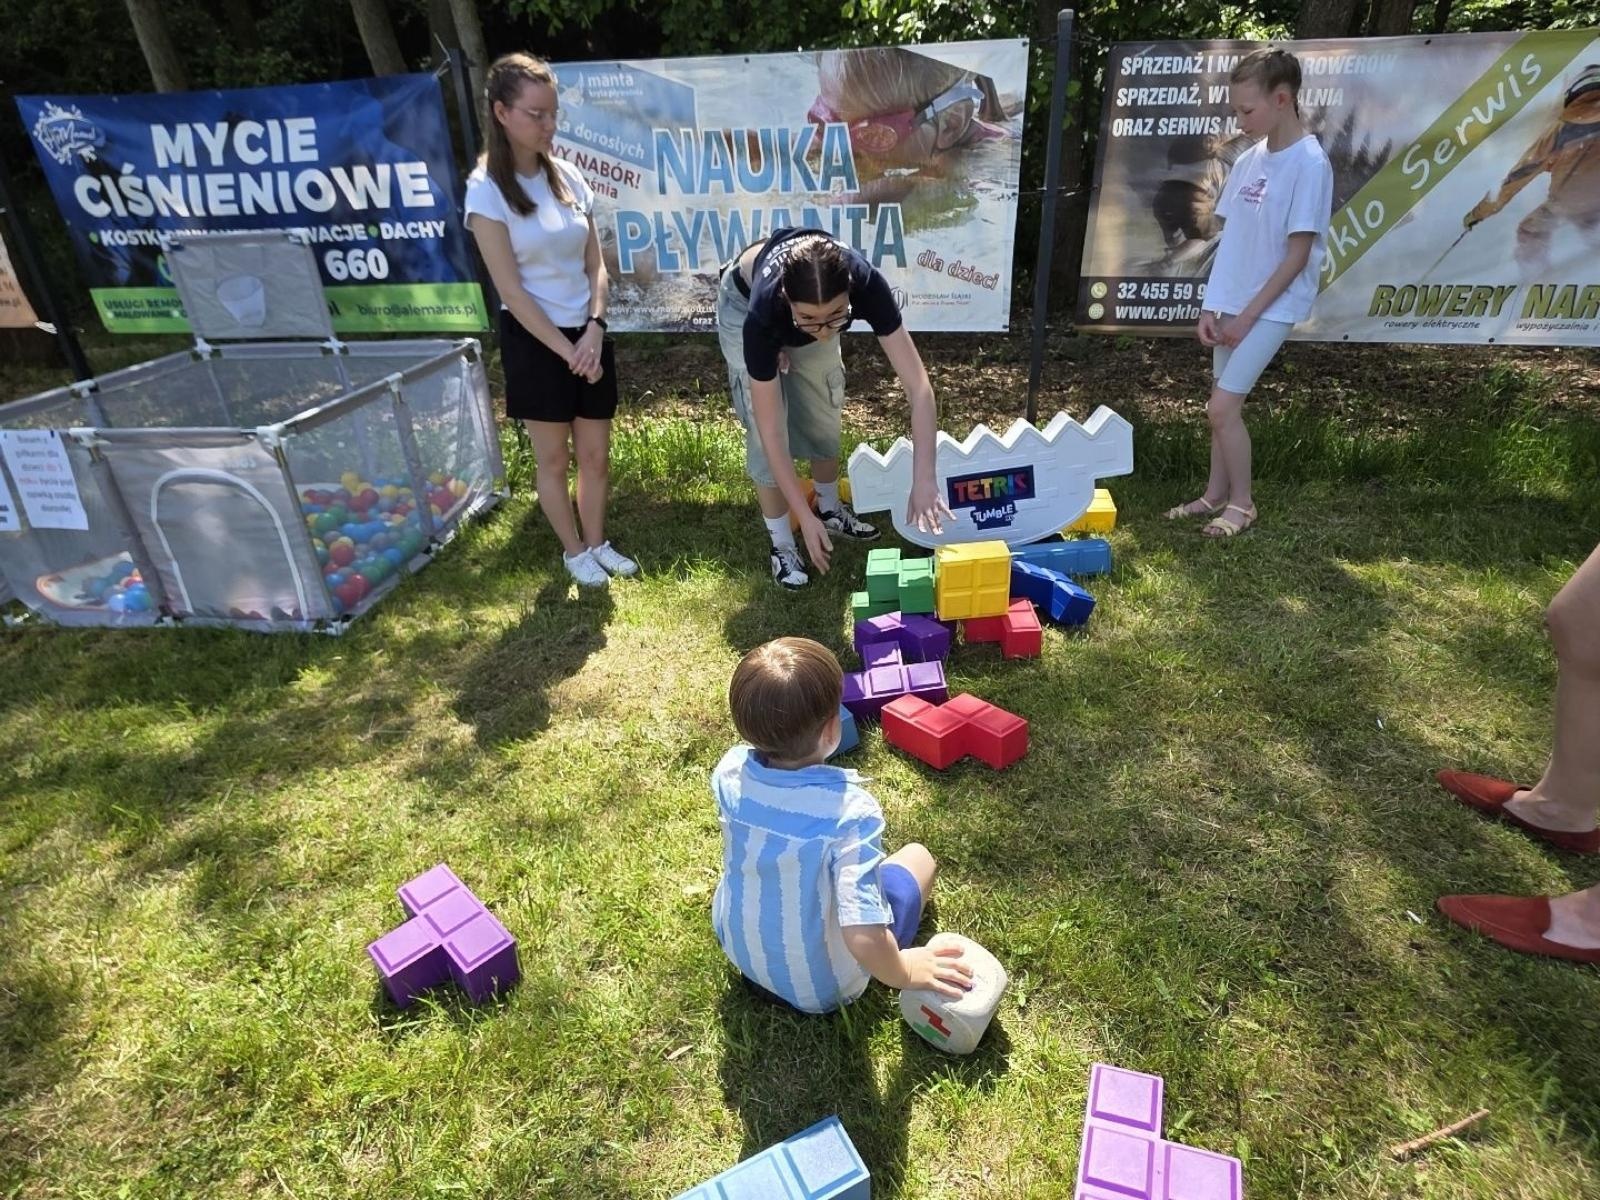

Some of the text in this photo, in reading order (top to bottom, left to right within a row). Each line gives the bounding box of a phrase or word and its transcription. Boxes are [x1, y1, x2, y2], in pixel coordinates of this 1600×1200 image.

[1120, 52, 1204, 76] SPRZEDAŻ
[1207, 55, 1214, 73] I
[587, 73, 634, 88] manta
[1117, 82, 1202, 107] SPRZEDAŻ,
[1112, 117, 1155, 138] ORAZ
[1157, 116, 1222, 136] SERWIS
[151, 117, 320, 169] MYCIE
[574, 122, 645, 160] dorosłych
[550, 143, 642, 190] WY NABÓR!
[652, 121, 861, 197] NAUKA
[1320, 53, 1542, 284] yklo Serwis
[73, 161, 436, 219] CIŚNIENIOWE
[586, 177, 619, 200] śnia
[379, 220, 446, 240] DACHY
[324, 247, 389, 281] 660
[917, 249, 1000, 291] dla dzieci
[1117, 282, 1208, 300] 32 455 59 9
[1367, 284, 1518, 318] ROWERY
[357, 302, 478, 317] biuro@alemaras.pl
[692, 317, 713, 326] oraz
[1115, 303, 1202, 322] www.cyklo
[1383, 318, 1481, 329] rowery elektryczne
[953, 472, 1028, 503] TETRIS
[972, 504, 1014, 523] TUMBLE
